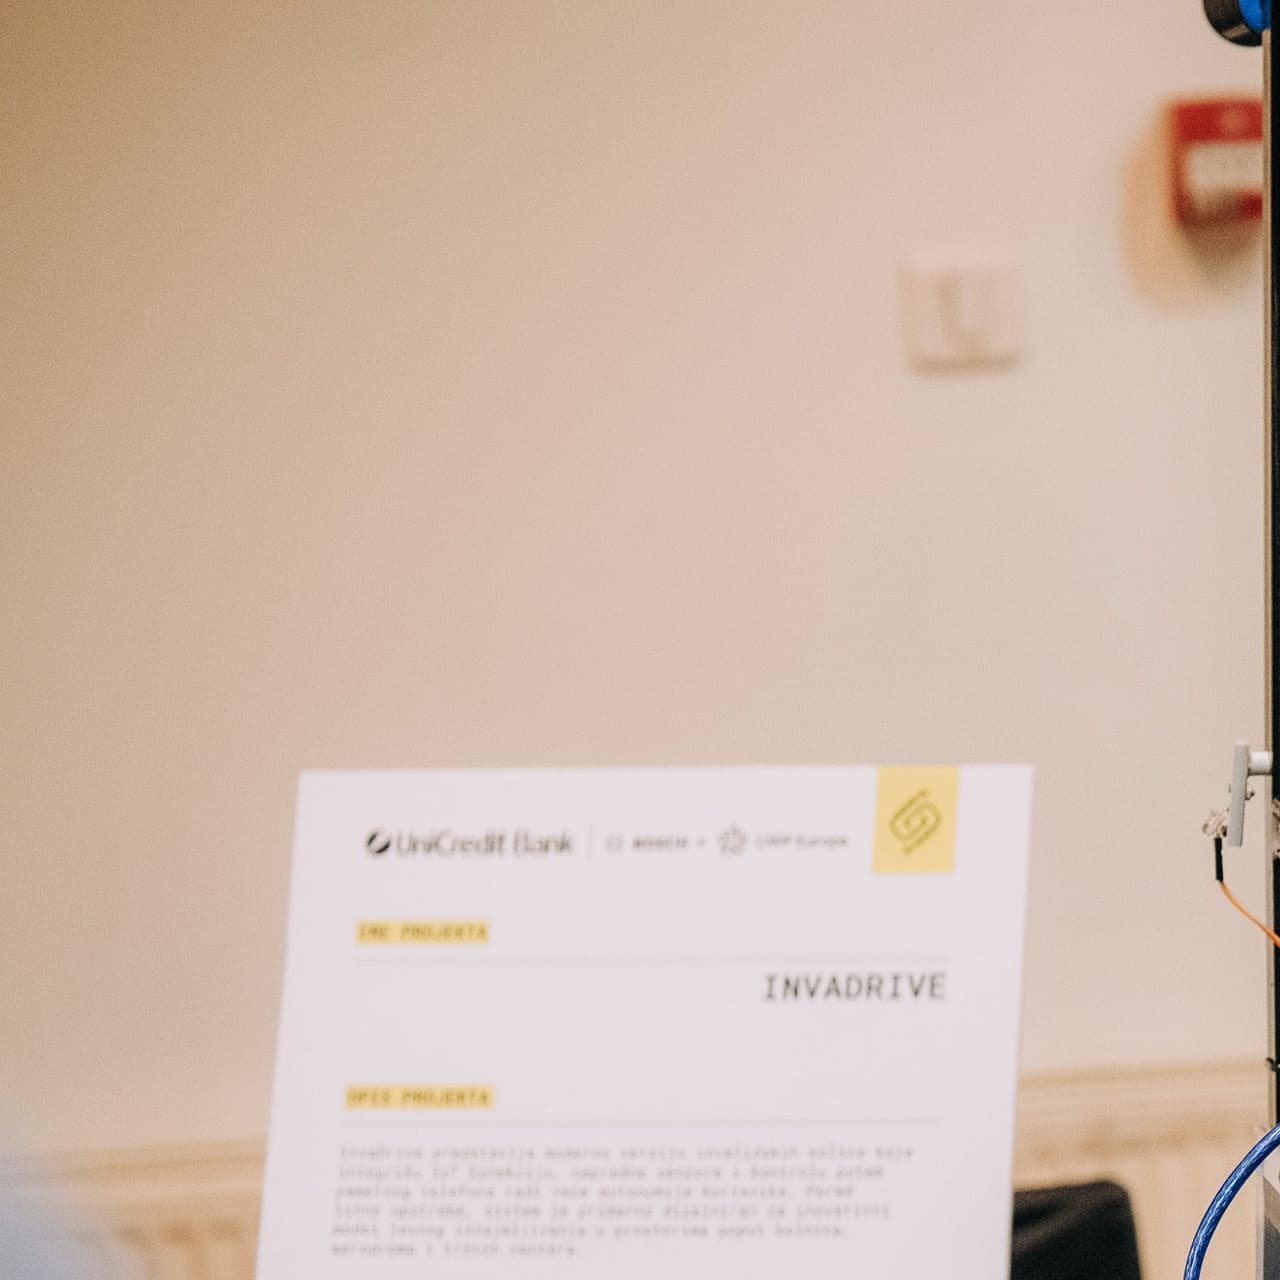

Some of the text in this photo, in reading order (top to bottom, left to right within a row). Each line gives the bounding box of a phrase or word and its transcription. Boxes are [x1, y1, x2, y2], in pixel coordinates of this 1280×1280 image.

[397, 830, 504, 856] UniCredit
[513, 831, 572, 855] Bank
[401, 924, 488, 942] PROJEKTA
[763, 972, 947, 1001] INVADRIVE
[347, 1089, 490, 1106] OPIS PROJEKTA
